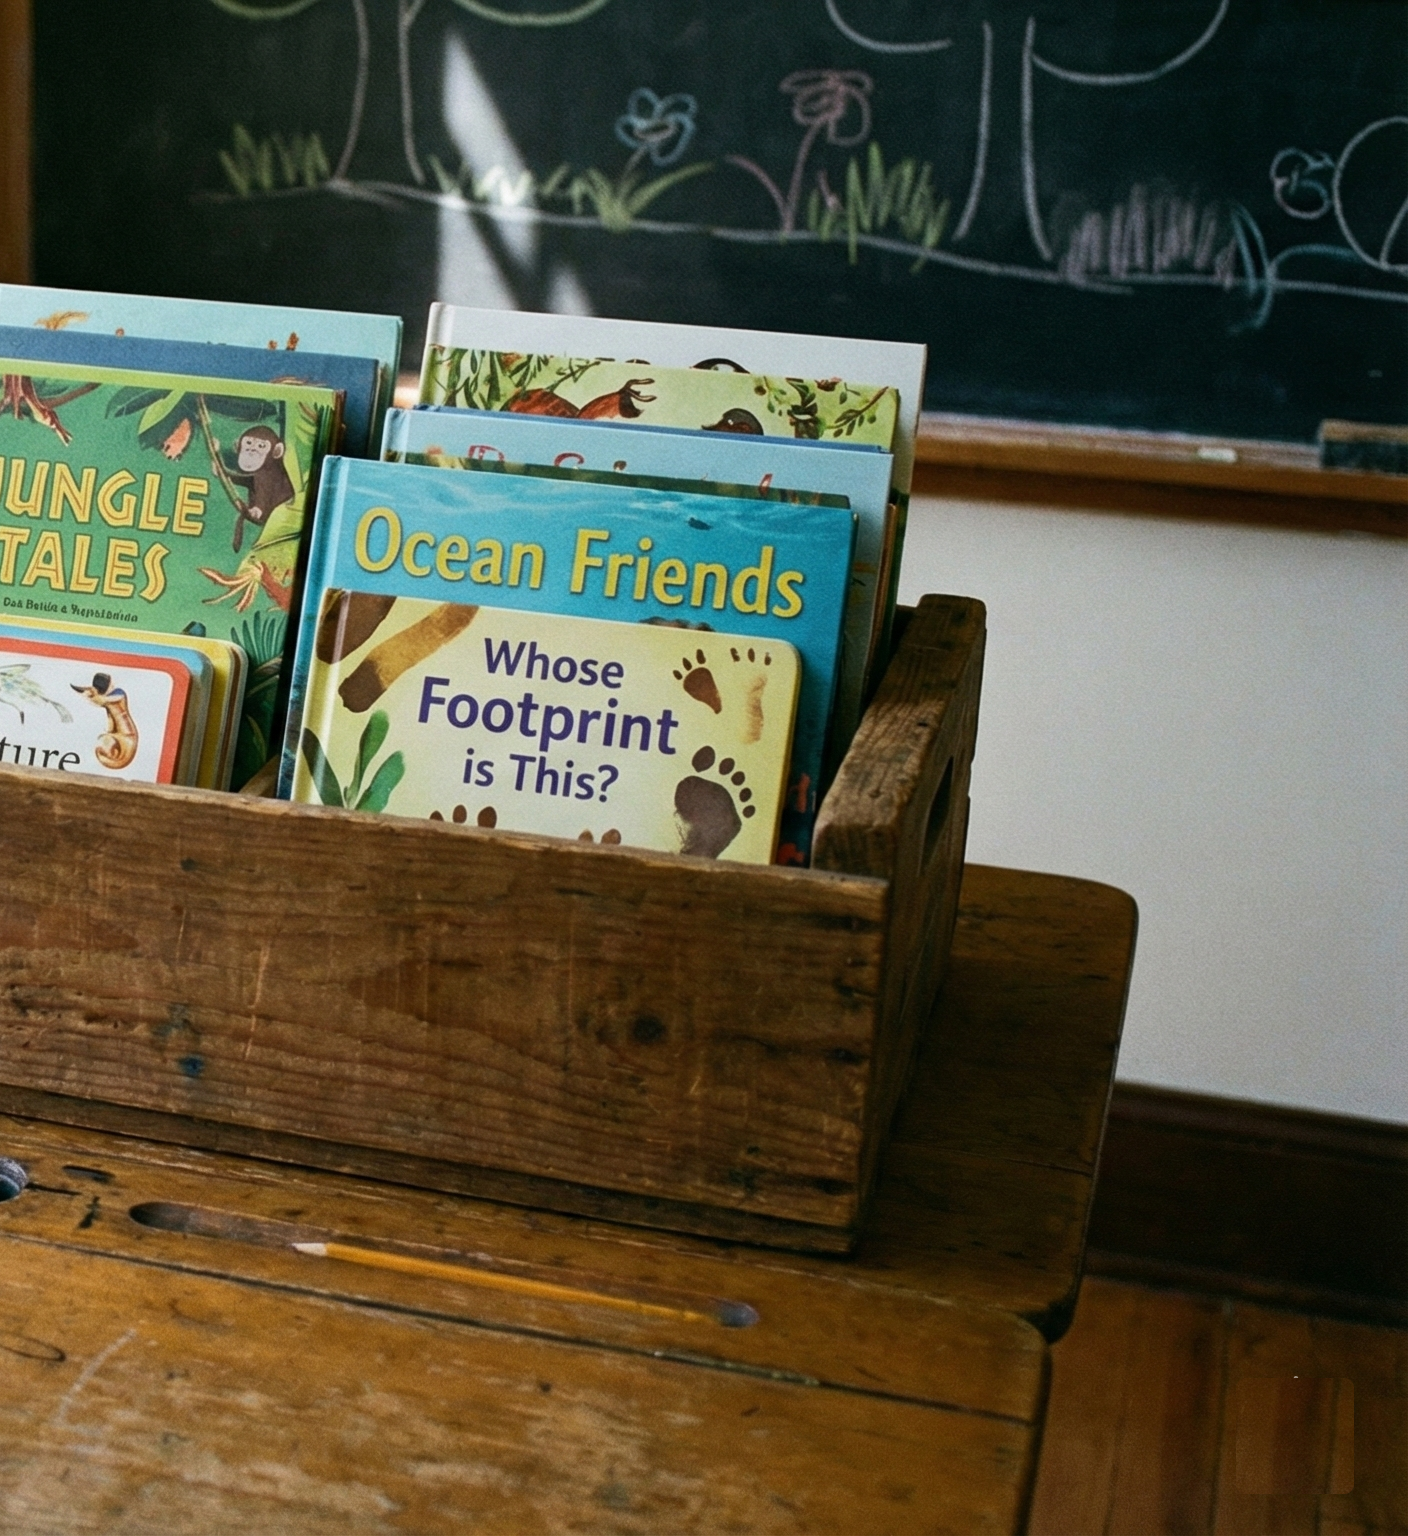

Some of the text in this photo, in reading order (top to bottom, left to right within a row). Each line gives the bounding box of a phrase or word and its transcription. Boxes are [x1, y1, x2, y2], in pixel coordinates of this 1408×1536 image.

[353, 506, 805, 619] Ocean Friends
[484, 637, 625, 690] Whose
[417, 676, 680, 756] Footprint
[462, 748, 620, 803] is This?
